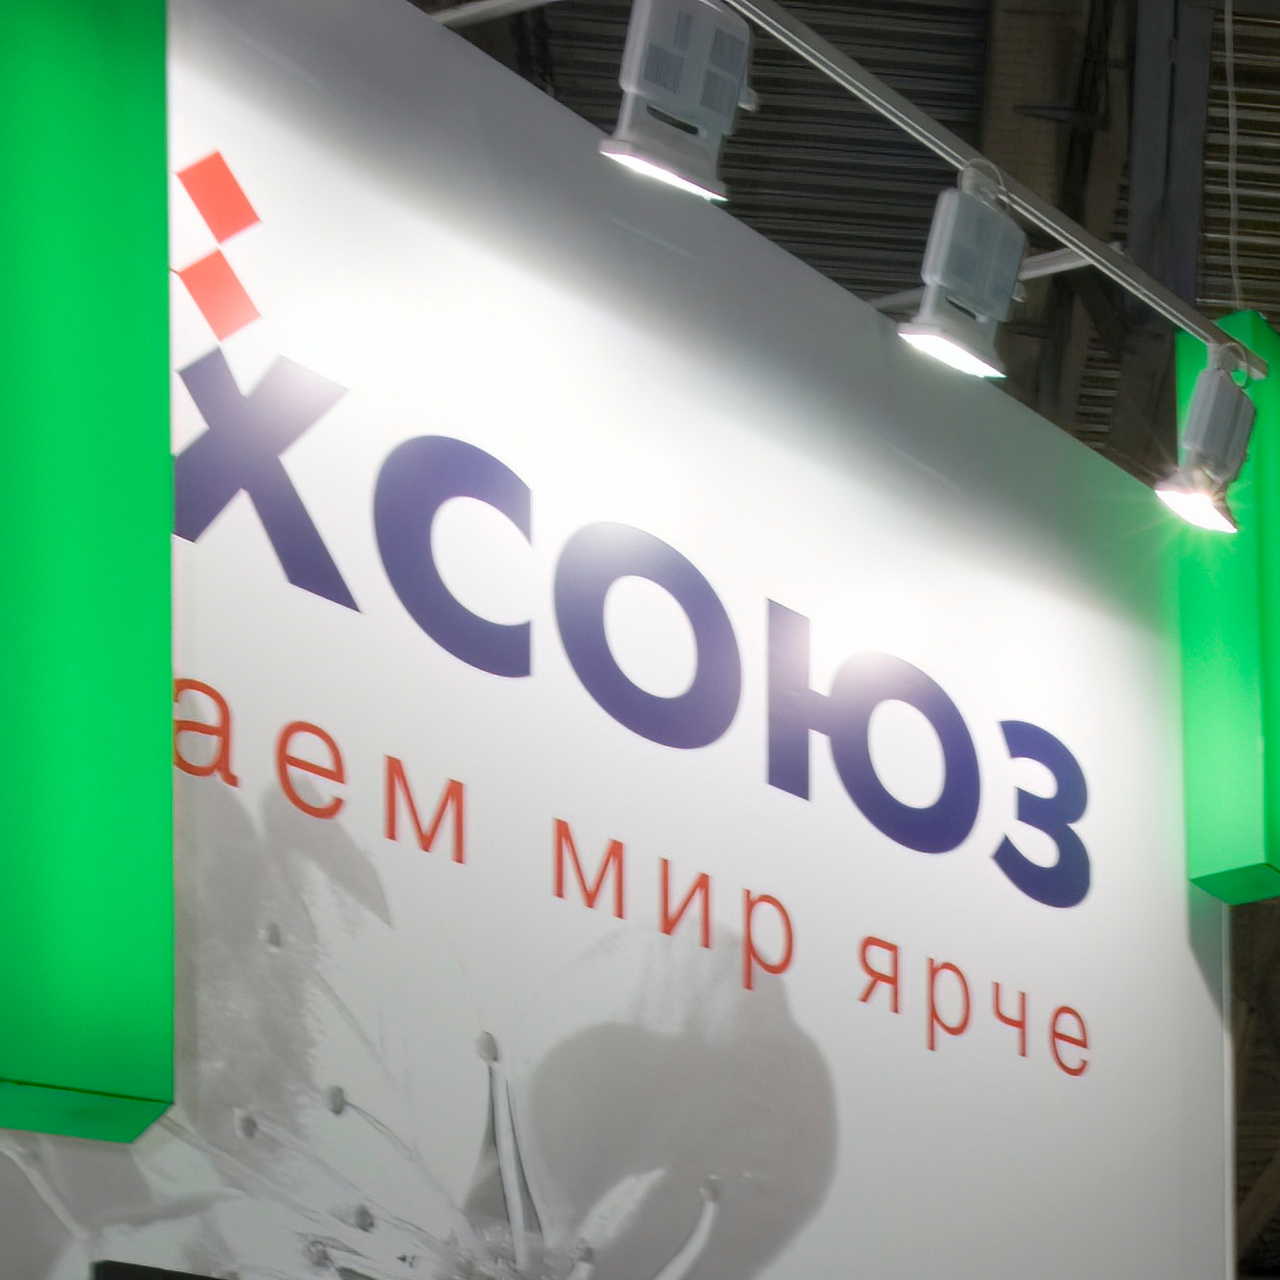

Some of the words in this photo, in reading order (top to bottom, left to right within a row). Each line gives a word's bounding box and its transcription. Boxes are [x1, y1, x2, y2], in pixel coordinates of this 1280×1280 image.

[172, 345, 1091, 908] ХСОЮЗ
[173, 677, 466, 865] аем
[553, 817, 795, 991] мир
[858, 935, 1090, 1077] ярче
